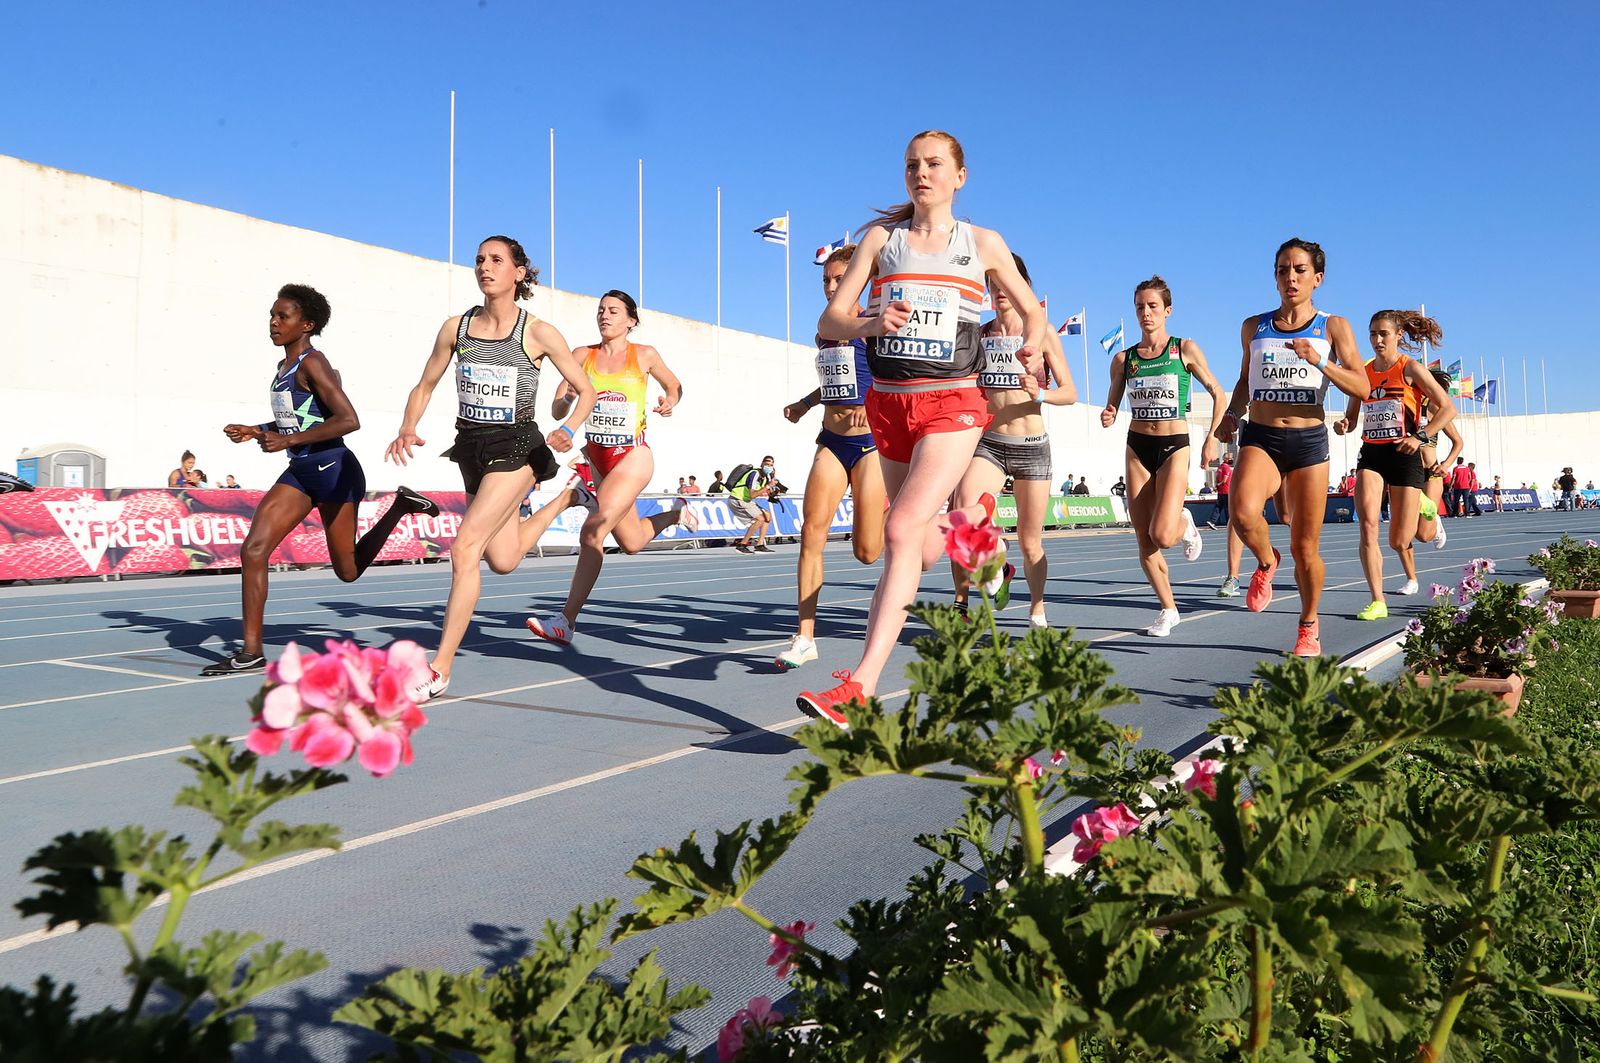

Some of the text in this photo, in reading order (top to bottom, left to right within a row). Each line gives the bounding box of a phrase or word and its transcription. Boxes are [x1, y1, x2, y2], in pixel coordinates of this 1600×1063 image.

[917, 295, 948, 304] HUELVA
[909, 309, 943, 326] ATT
[906, 327, 918, 337] 21
[990, 352, 1013, 364] VAN
[819, 363, 850, 376] OBLES
[996, 365, 1005, 373] 22
[1261, 367, 1308, 379] CAMPO
[460, 380, 511, 398] BETICHE
[822, 386, 850, 398] oma
[475, 397, 484, 406] 29
[592, 415, 626, 427] PEREZ
[1067, 505, 1109, 517] IBERDROLA
